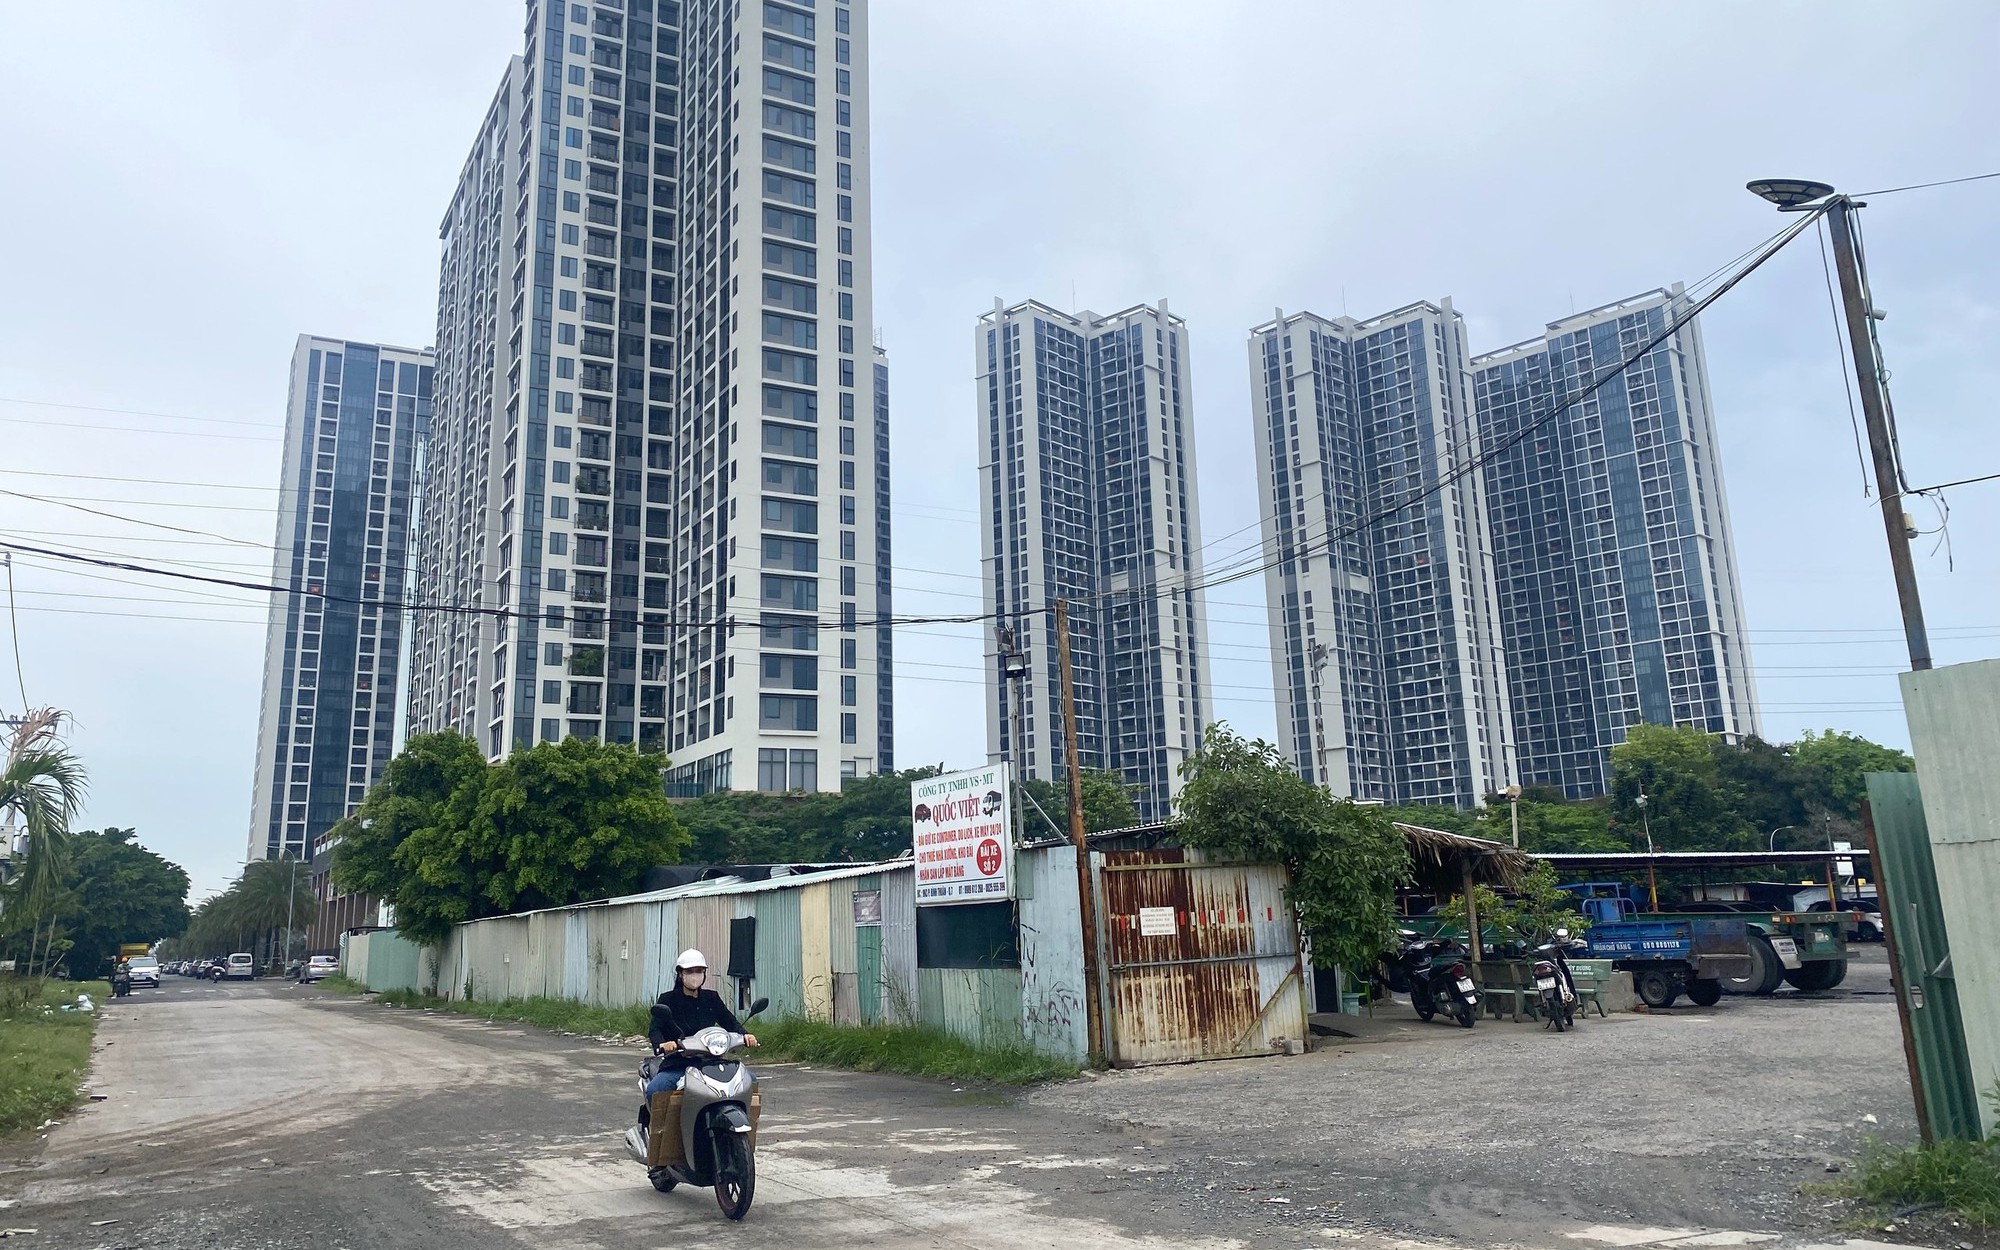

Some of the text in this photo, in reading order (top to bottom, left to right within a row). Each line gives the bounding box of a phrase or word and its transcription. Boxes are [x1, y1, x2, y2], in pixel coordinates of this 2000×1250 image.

[918, 784, 936, 798] CÔNG
[938, 782, 947, 794] TY
[948, 778, 968, 792] TNHH
[933, 793, 980, 827] QUỐC VIỆT
[990, 845, 997, 856] XE
[984, 857, 996, 872] SỐ 2
